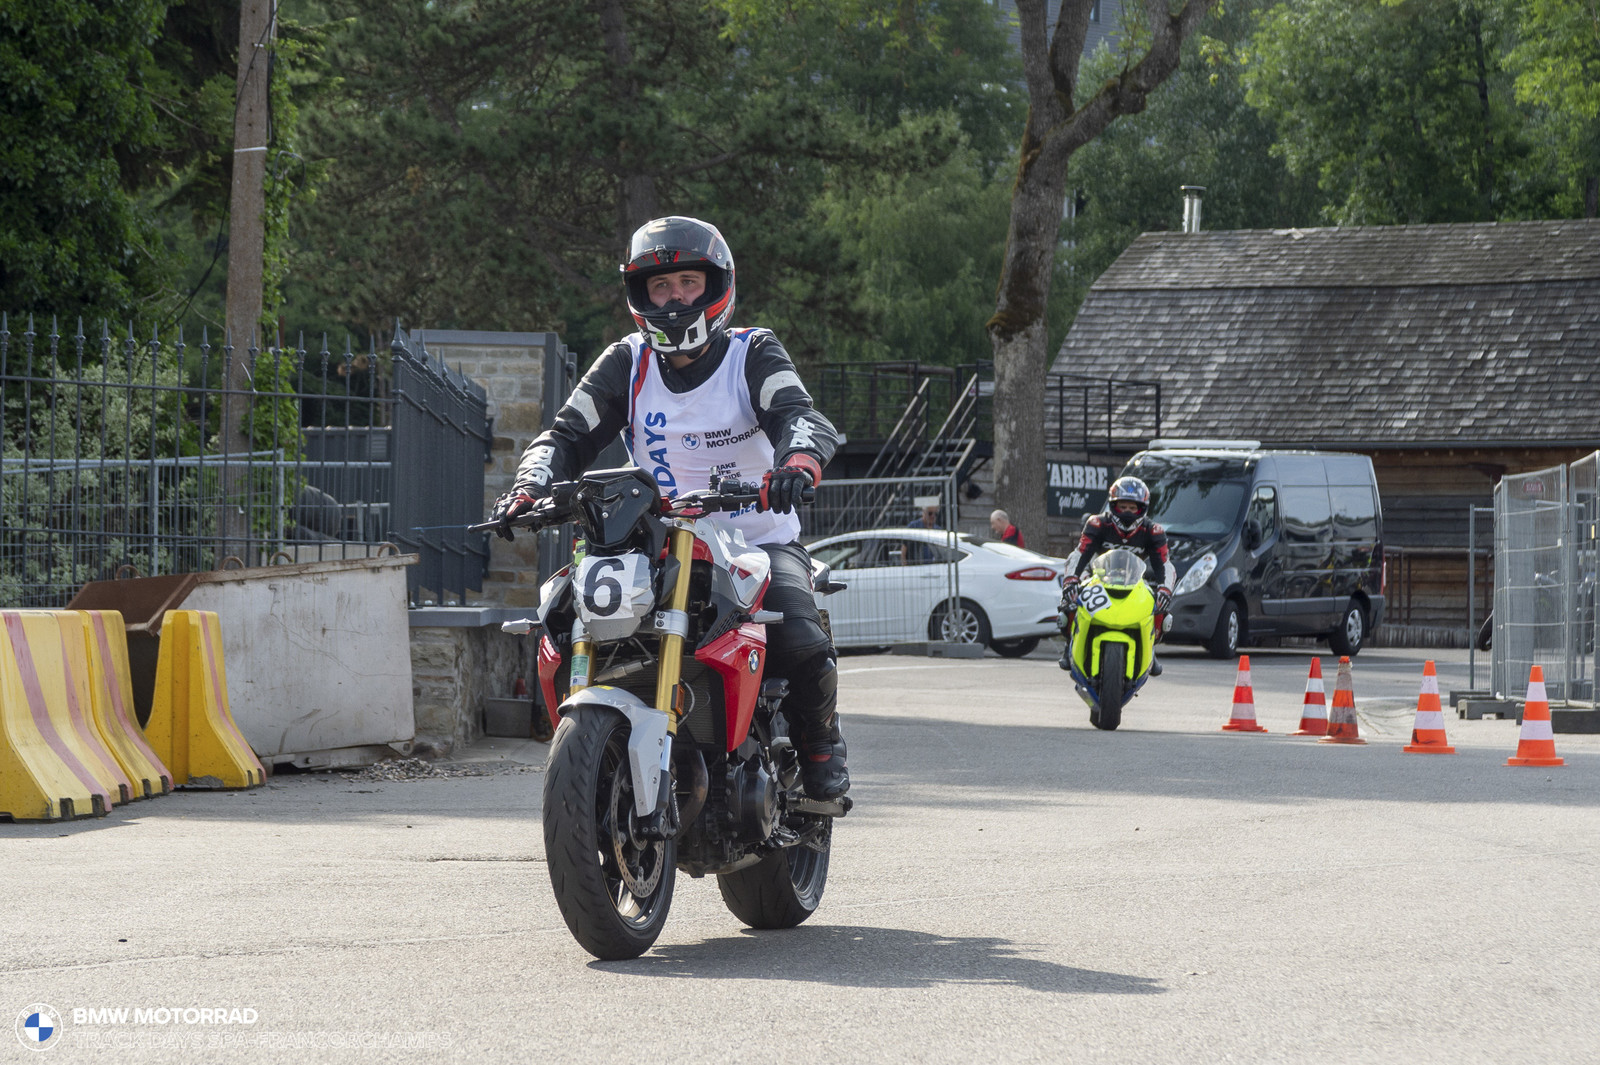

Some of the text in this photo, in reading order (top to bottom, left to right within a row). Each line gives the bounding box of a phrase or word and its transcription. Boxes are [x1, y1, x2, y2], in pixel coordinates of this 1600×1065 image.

[704, 428, 731, 439] BMW
[706, 425, 761, 448] MOTORRAD
[583, 558, 625, 617] 6
[1081, 585, 1108, 613] 89
